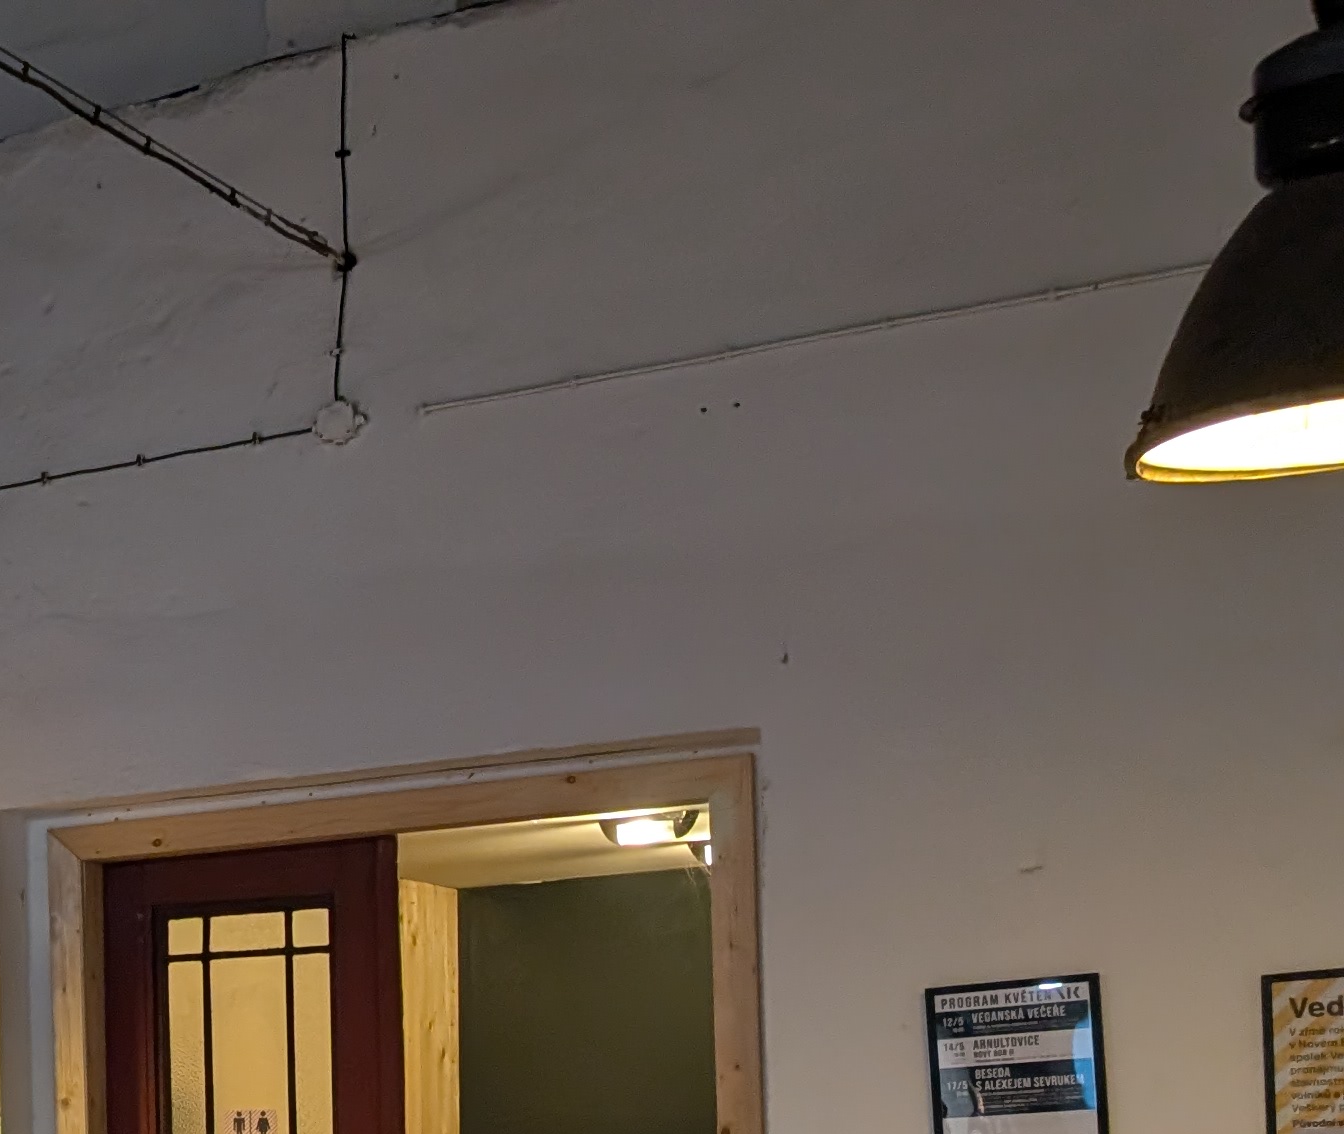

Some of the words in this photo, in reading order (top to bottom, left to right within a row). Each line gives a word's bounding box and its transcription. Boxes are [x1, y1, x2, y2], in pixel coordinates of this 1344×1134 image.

[941, 994, 999, 1010] PROGRAM
[1289, 995, 1344, 1018] Ved
[973, 1034, 1040, 1051] ARNULTOVICE
[975, 1066, 1011, 1080] BESEDA
[975, 1080, 983, 1092] S
[984, 1077, 1032, 1091] ALEXEJEM
